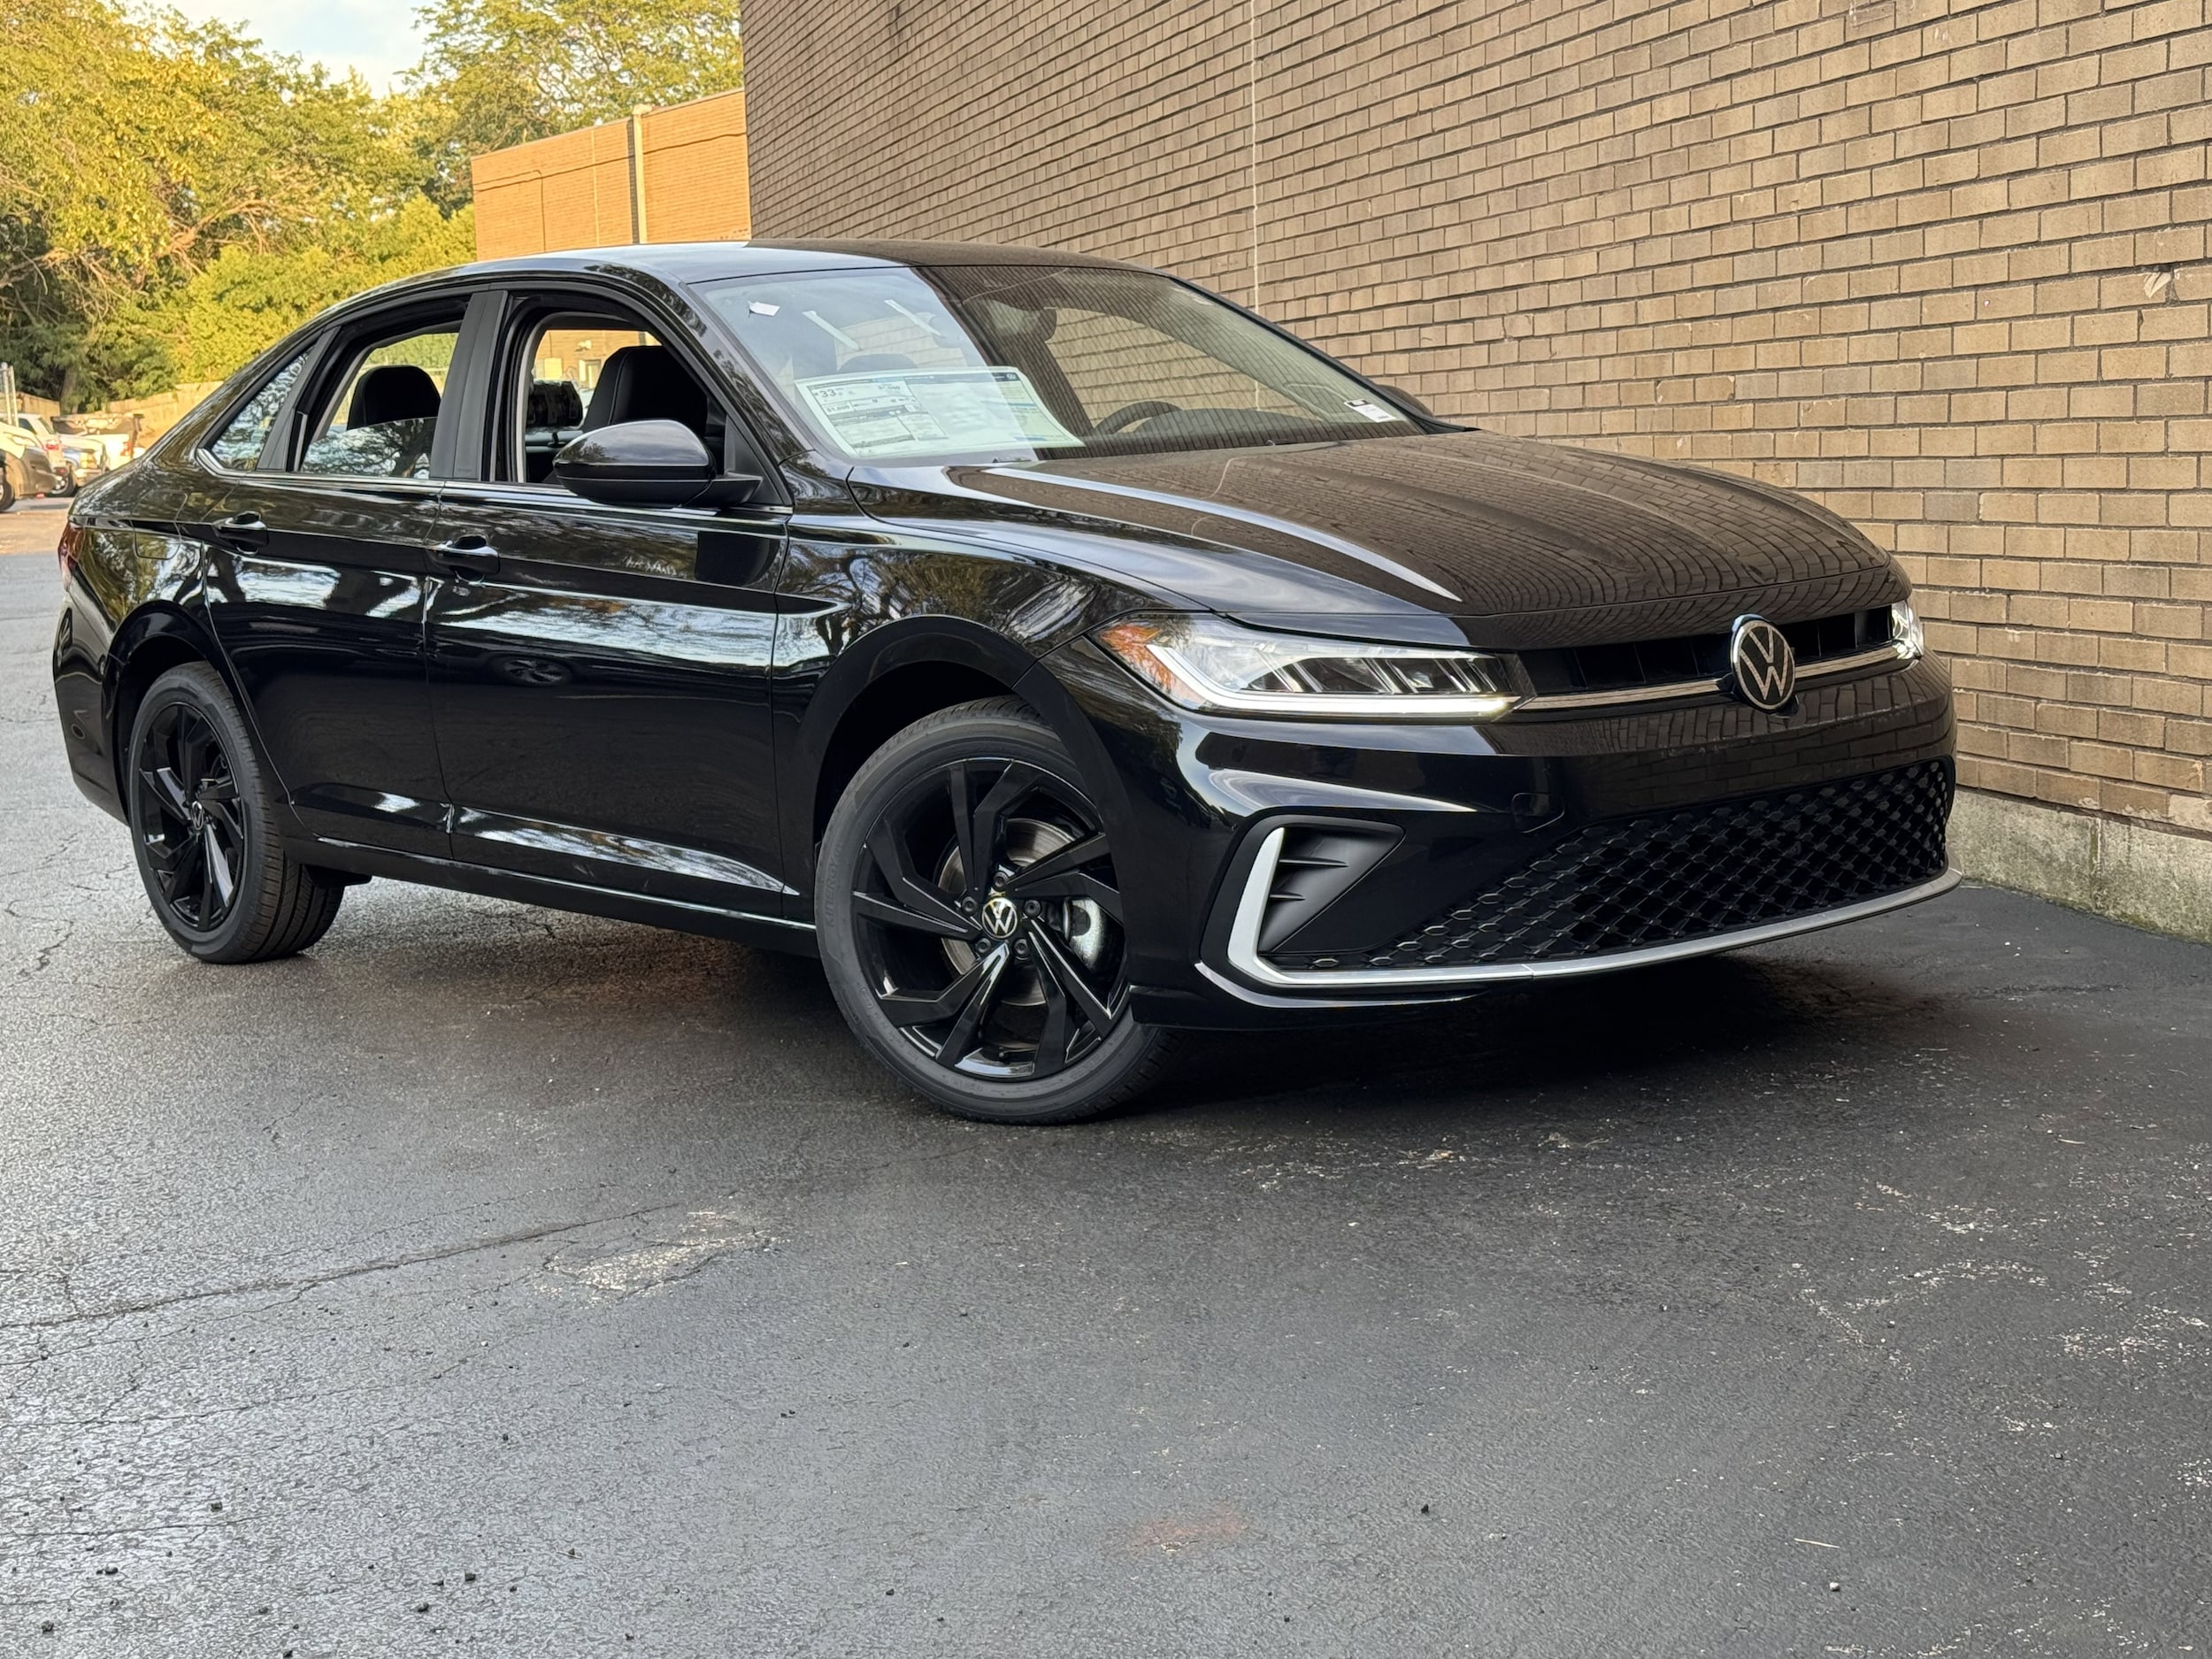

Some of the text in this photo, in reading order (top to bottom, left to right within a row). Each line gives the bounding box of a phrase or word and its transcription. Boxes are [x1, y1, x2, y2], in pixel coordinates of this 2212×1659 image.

[819, 388, 836, 398] 33
[1738, 624, 1791, 703] VW
[824, 857, 837, 928] KINERGY
[983, 899, 1015, 936] VW
